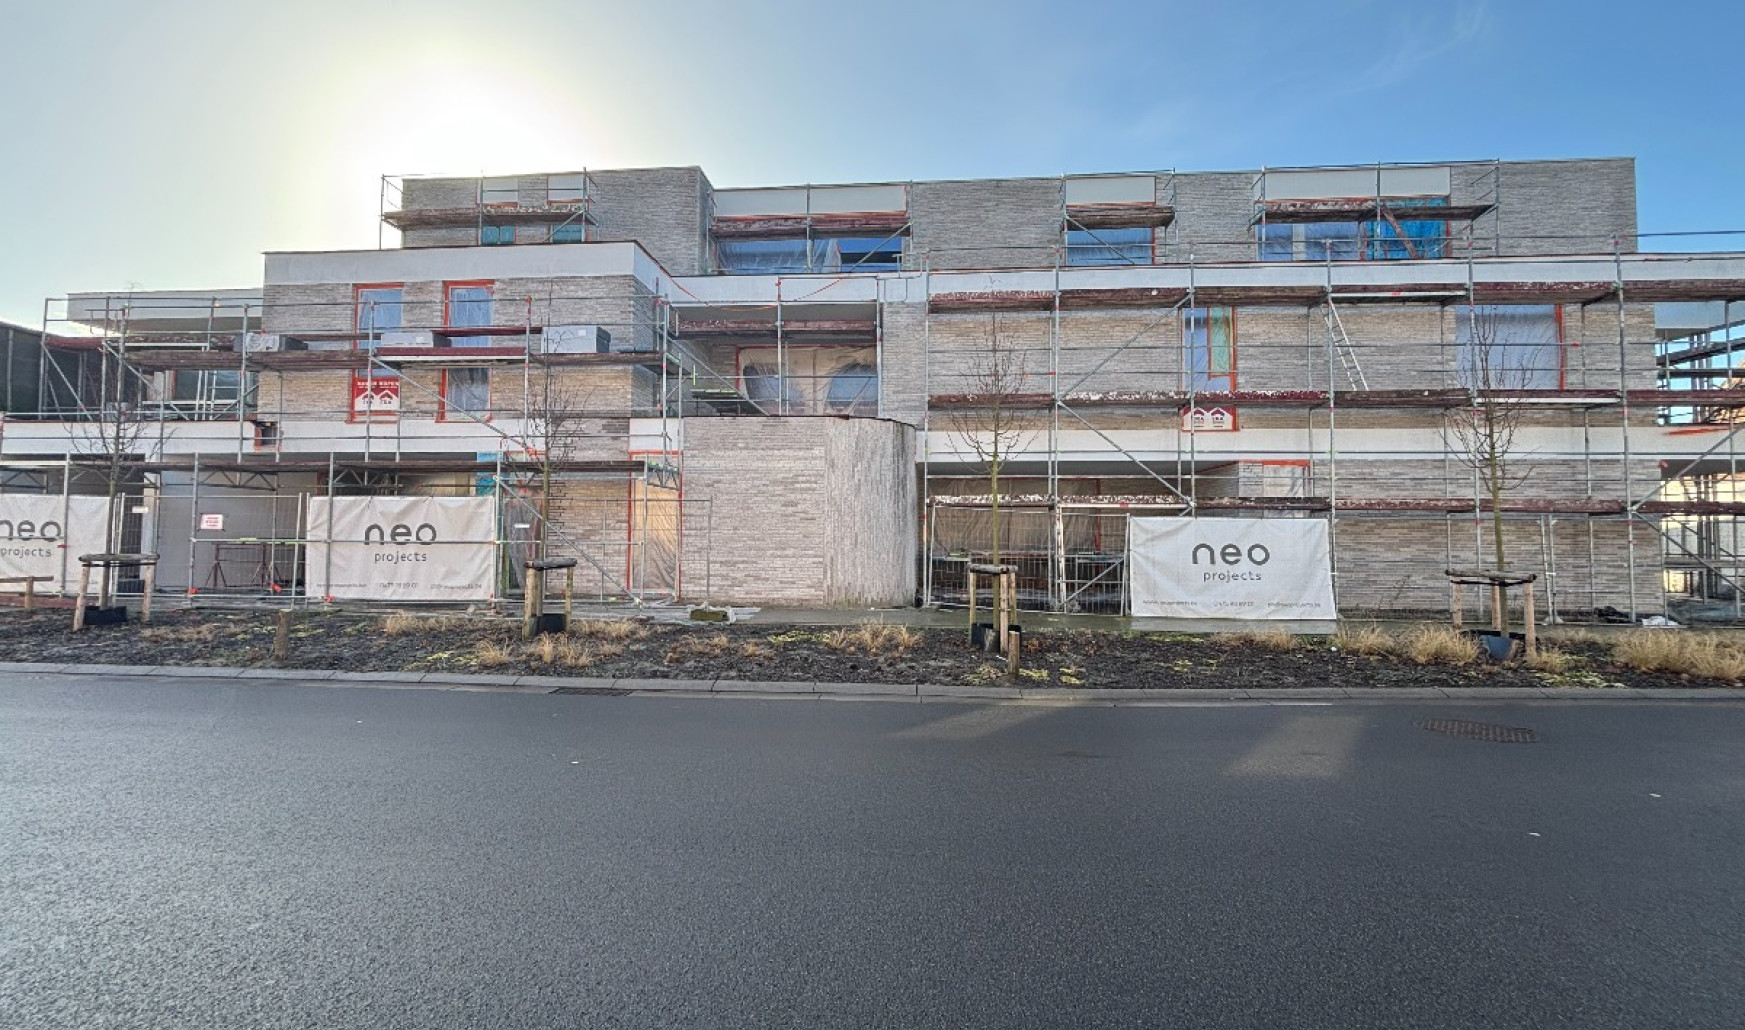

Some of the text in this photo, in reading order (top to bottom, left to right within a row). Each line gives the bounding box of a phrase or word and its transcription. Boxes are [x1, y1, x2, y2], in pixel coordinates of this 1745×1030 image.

[364, 522, 437, 546] neo
[0, 546, 52, 559] projects
[374, 551, 427, 565] projects
[1191, 543, 1271, 566] neo
[1203, 570, 1262, 584] projects
